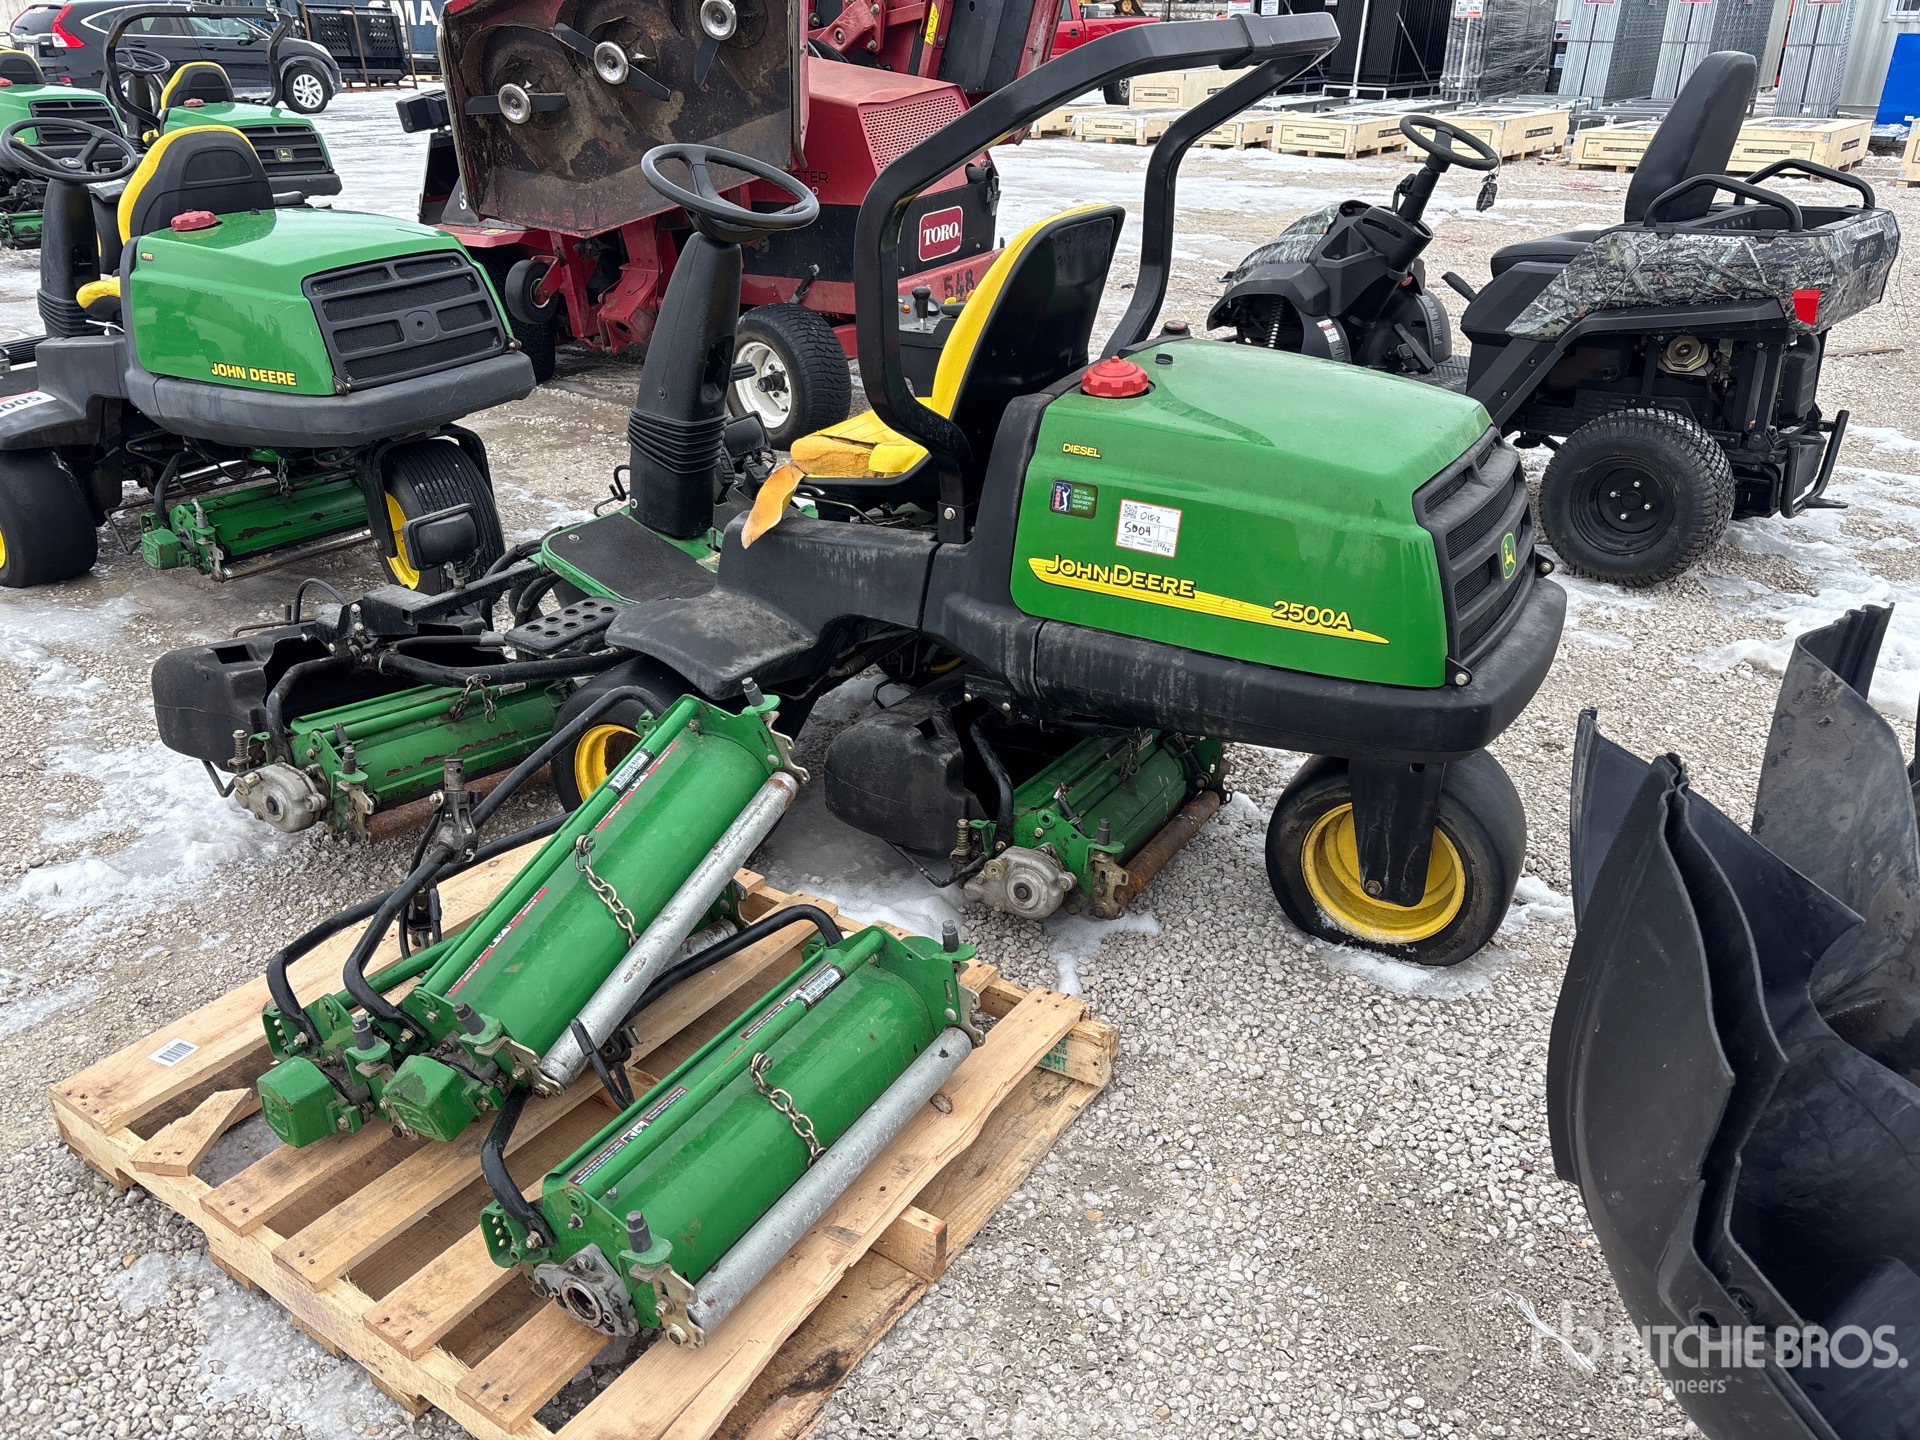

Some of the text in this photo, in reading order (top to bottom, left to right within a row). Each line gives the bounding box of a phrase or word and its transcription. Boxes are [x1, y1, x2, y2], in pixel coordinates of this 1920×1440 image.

[368, 0, 439, 26] MA
[923, 221, 960, 246] TORO
[943, 268, 975, 299] 548
[211, 361, 298, 387] JOHN DEERE
[1062, 442, 1102, 459] DIESEL
[1046, 553, 1196, 599] JOHN DEERE
[1271, 599, 1354, 632] 2500A
